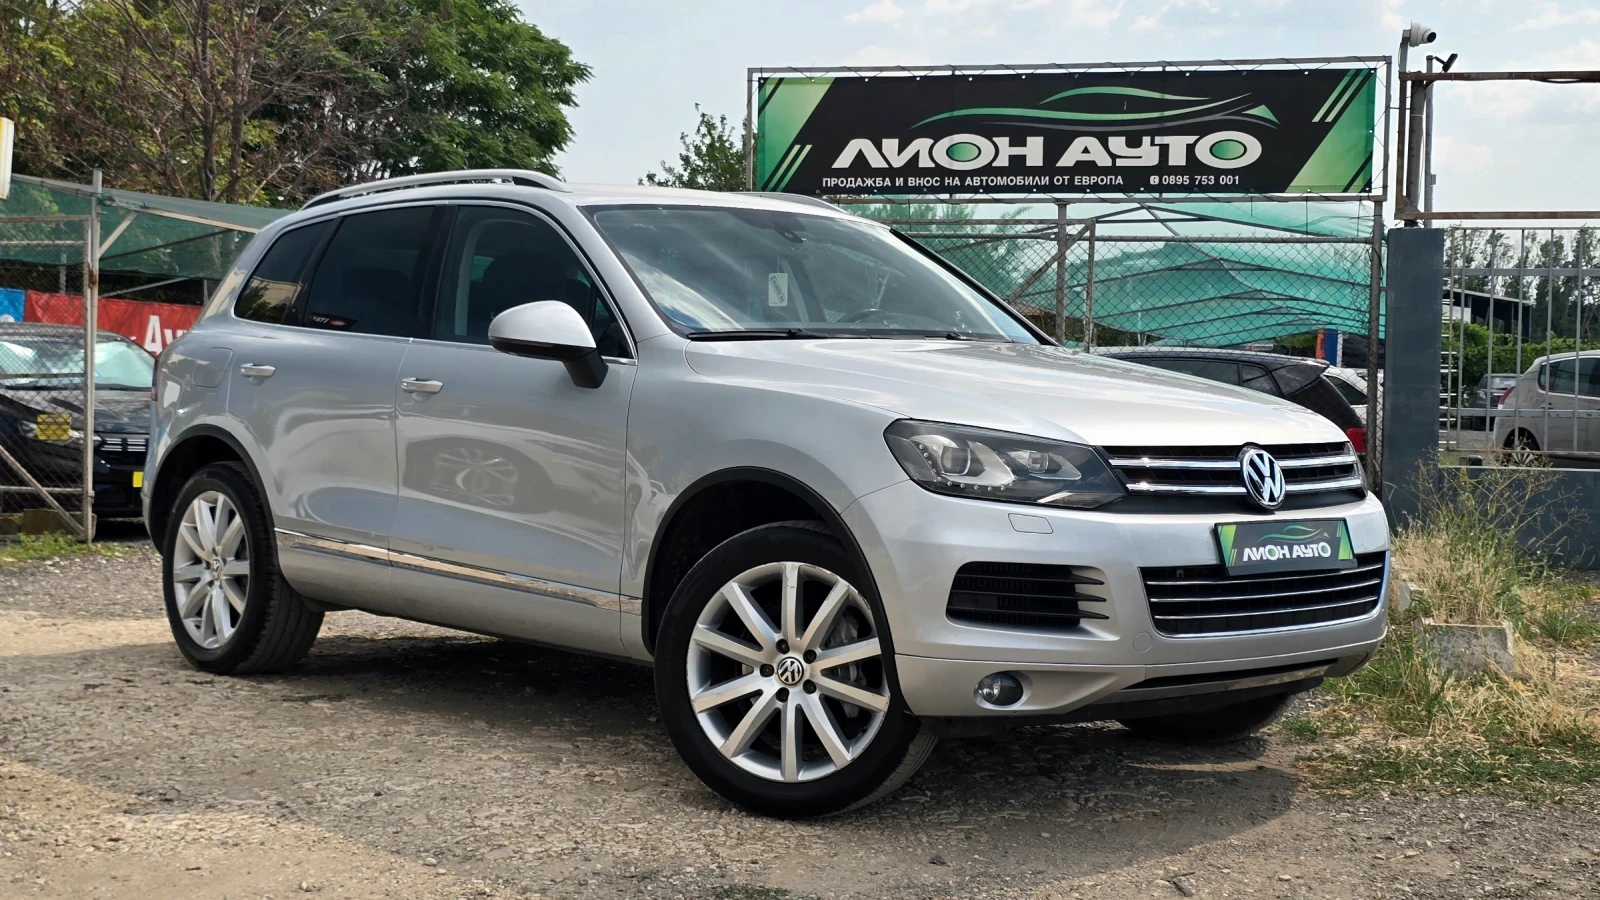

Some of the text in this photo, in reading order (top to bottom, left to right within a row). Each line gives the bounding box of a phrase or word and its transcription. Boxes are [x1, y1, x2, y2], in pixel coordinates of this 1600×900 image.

[831, 130, 1263, 171] ЛИОН АУТО
[822, 175, 1124, 188] ПРОДАЖБА И ВНОС НА АВТОМОБИЛИ ОТ ЕВРОПА
[1162, 175, 1240, 185] 0895 753 001
[1242, 541, 1332, 562] ЛИОН АУТО
